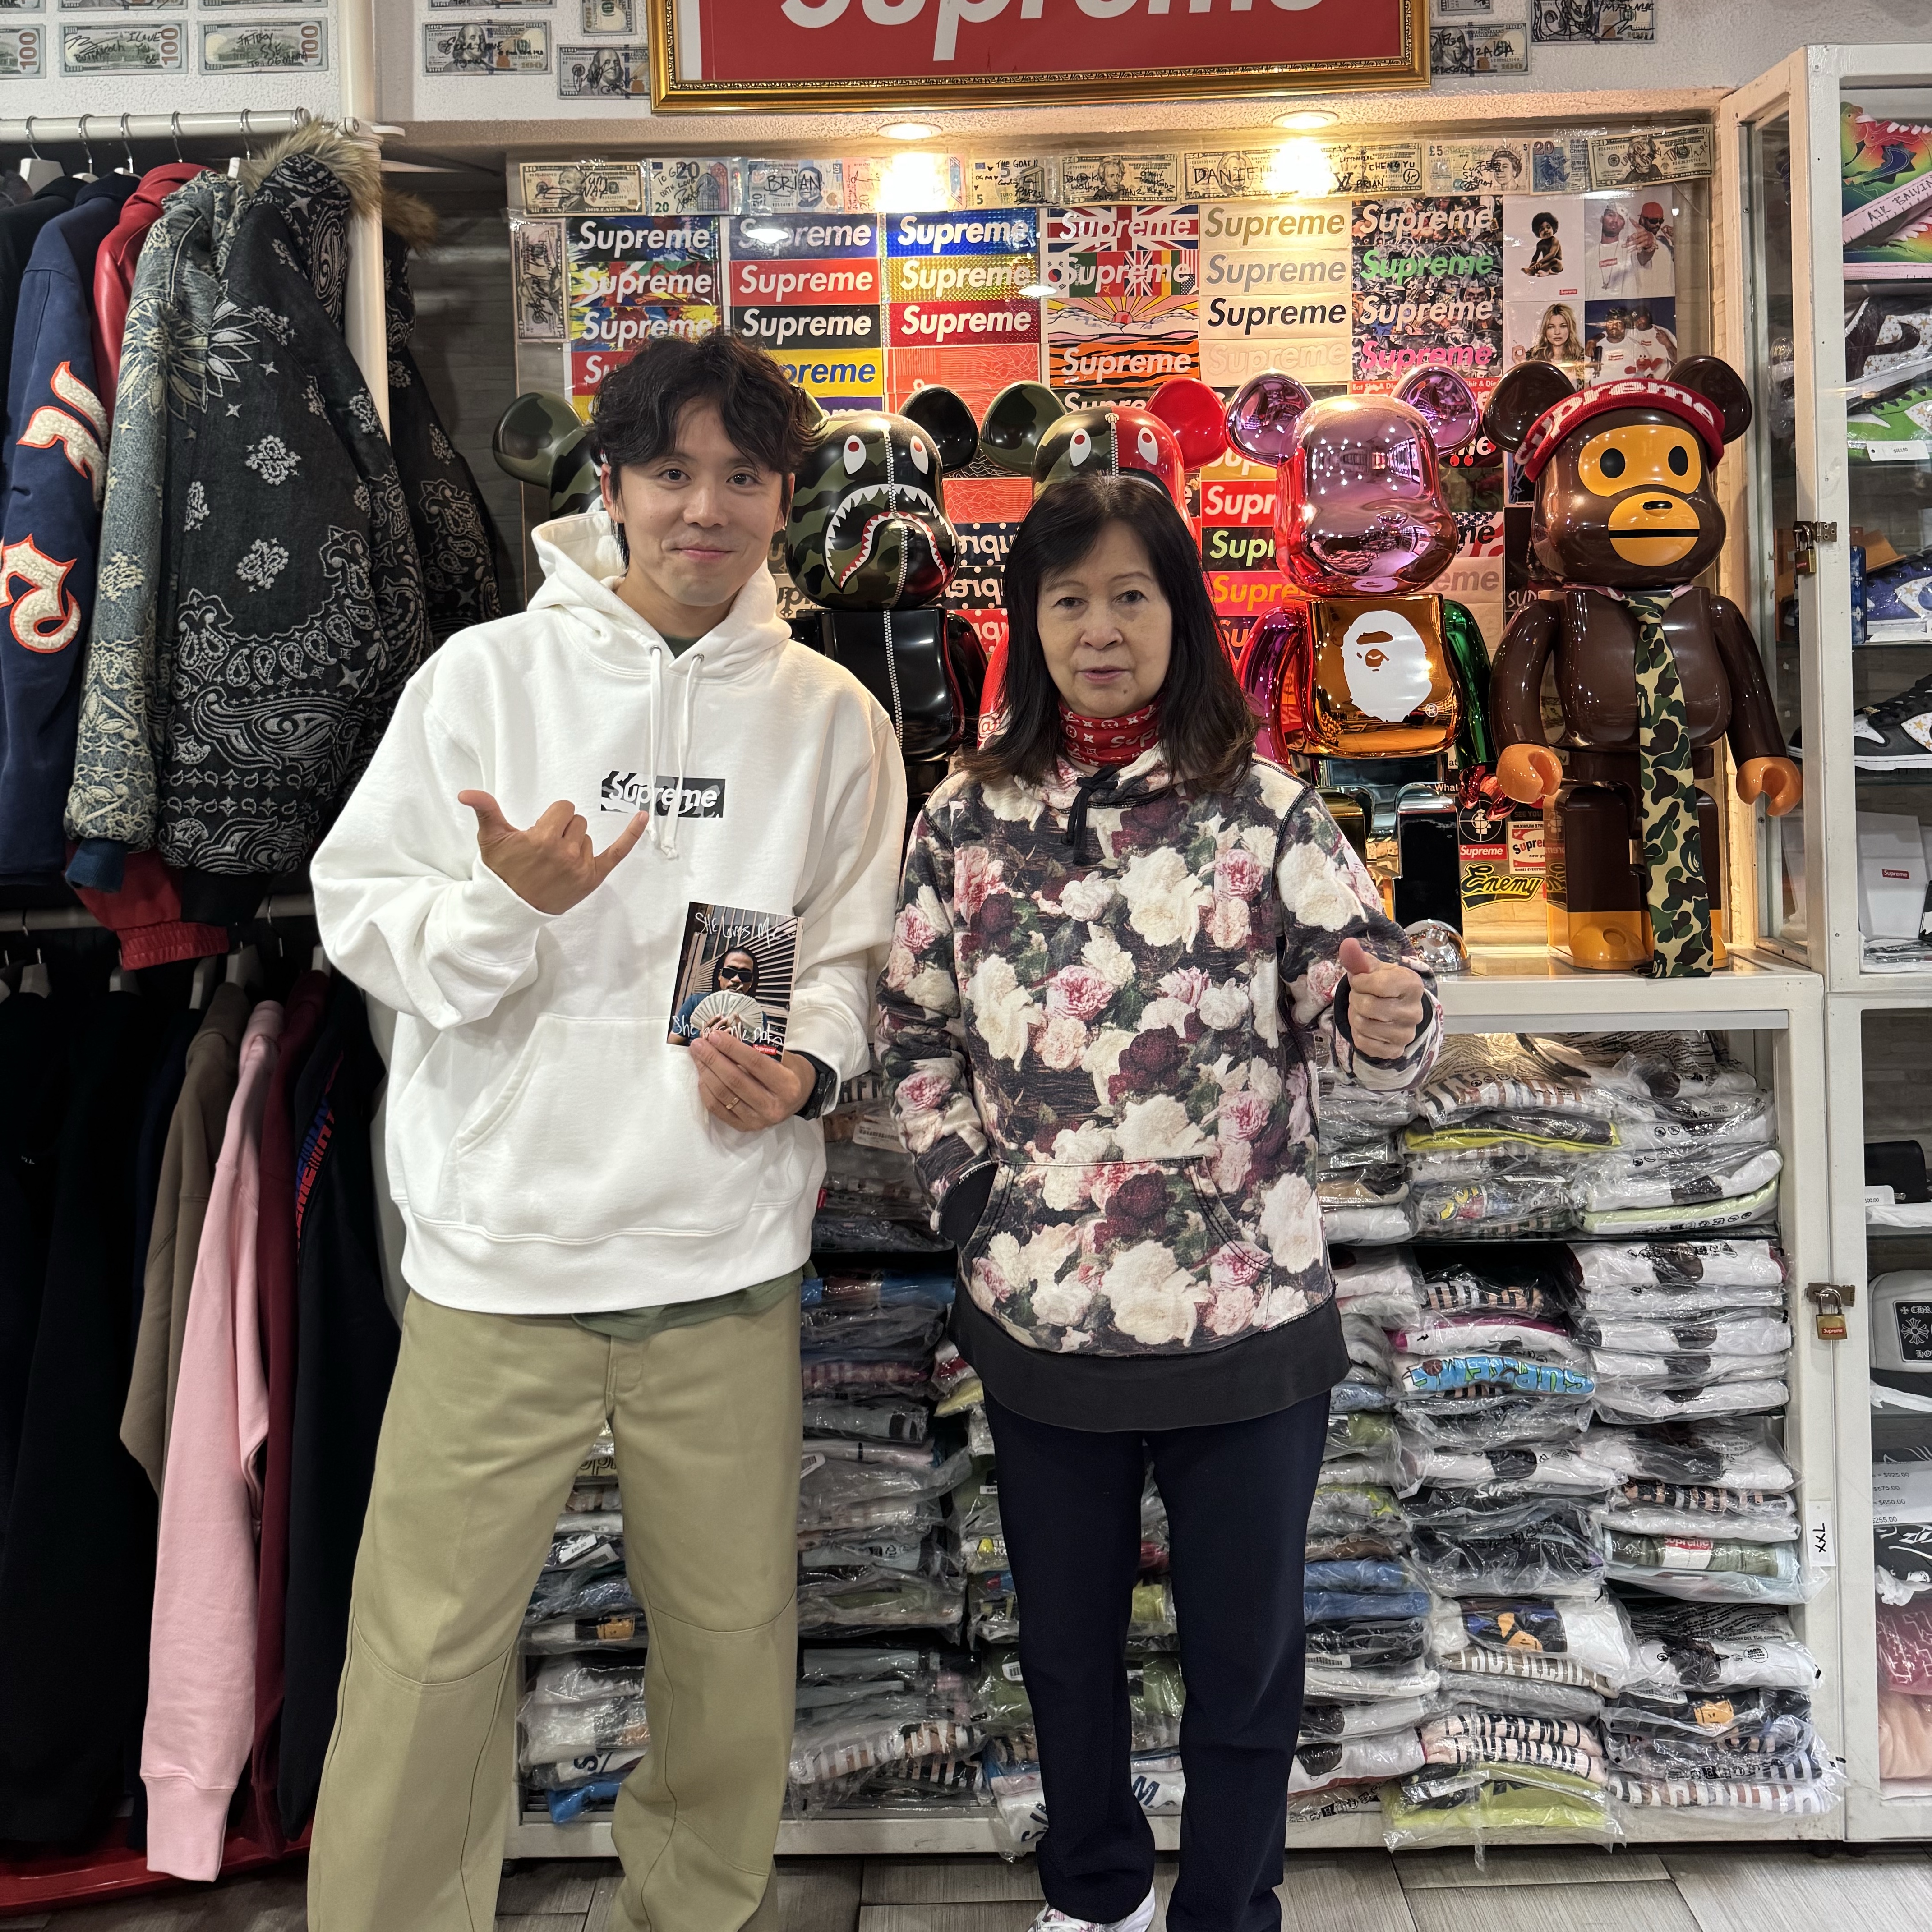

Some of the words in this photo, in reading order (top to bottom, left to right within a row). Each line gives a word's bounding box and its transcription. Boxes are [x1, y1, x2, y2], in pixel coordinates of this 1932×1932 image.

[19, 32, 37, 70] 100
[161, 28, 179, 65] 100
[301, 25, 318, 63] 100
[1013, 160, 1031, 168] GOAT
[1369, 161, 1400, 171] CHENG
[1429, 146, 1443, 156] £5
[1534, 141, 1554, 155] 20
[764, 174, 821, 192] BRIAN
[977, 194, 983, 205] 5
[1356, 179, 1383, 189] BRIAN
[655, 202, 669, 213] 20
[1360, 204, 1492, 242] Supreme
[1868, 205, 1891, 223] AIR
[578, 221, 710, 258] Supreme
[738, 218, 871, 256] Spreme
[898, 216, 1029, 253] Supreme
[1059, 212, 1190, 247] Supreme
[1205, 207, 1345, 246] Supreme
[581, 266, 712, 303] Supreme
[739, 265, 873, 302] Supreme
[900, 260, 1031, 298] Supreme
[1063, 256, 1191, 293] Supreme
[1206, 254, 1346, 293] Supreme
[1360, 249, 1494, 285] Supreme
[582, 311, 713, 351] Supreme
[741, 308, 872, 345] Supreme
[900, 305, 1032, 343] Supreme
[1207, 298, 1346, 335] Supreme
[1360, 295, 1493, 332] Supreme
[783, 363, 876, 383] reme
[1061, 347, 1191, 383] Supreme
[1207, 343, 1347, 376] Supreme
[1360, 340, 1493, 377] Supreme
[1514, 382, 1714, 465] upreme
[1204, 485, 1276, 524] Supr
[1213, 575, 1306, 611] Supre
[609, 771, 718, 810] Supreme
[1460, 845, 1503, 859] Supreme
[1512, 838, 1545, 855] Supre
[1461, 862, 1545, 901] Enemy
[758, 917, 781, 948] Me
[672, 1015, 696, 1037] She
[754, 1045, 776, 1055] Supreme
[1813, 1523, 1826, 1553] XXL
